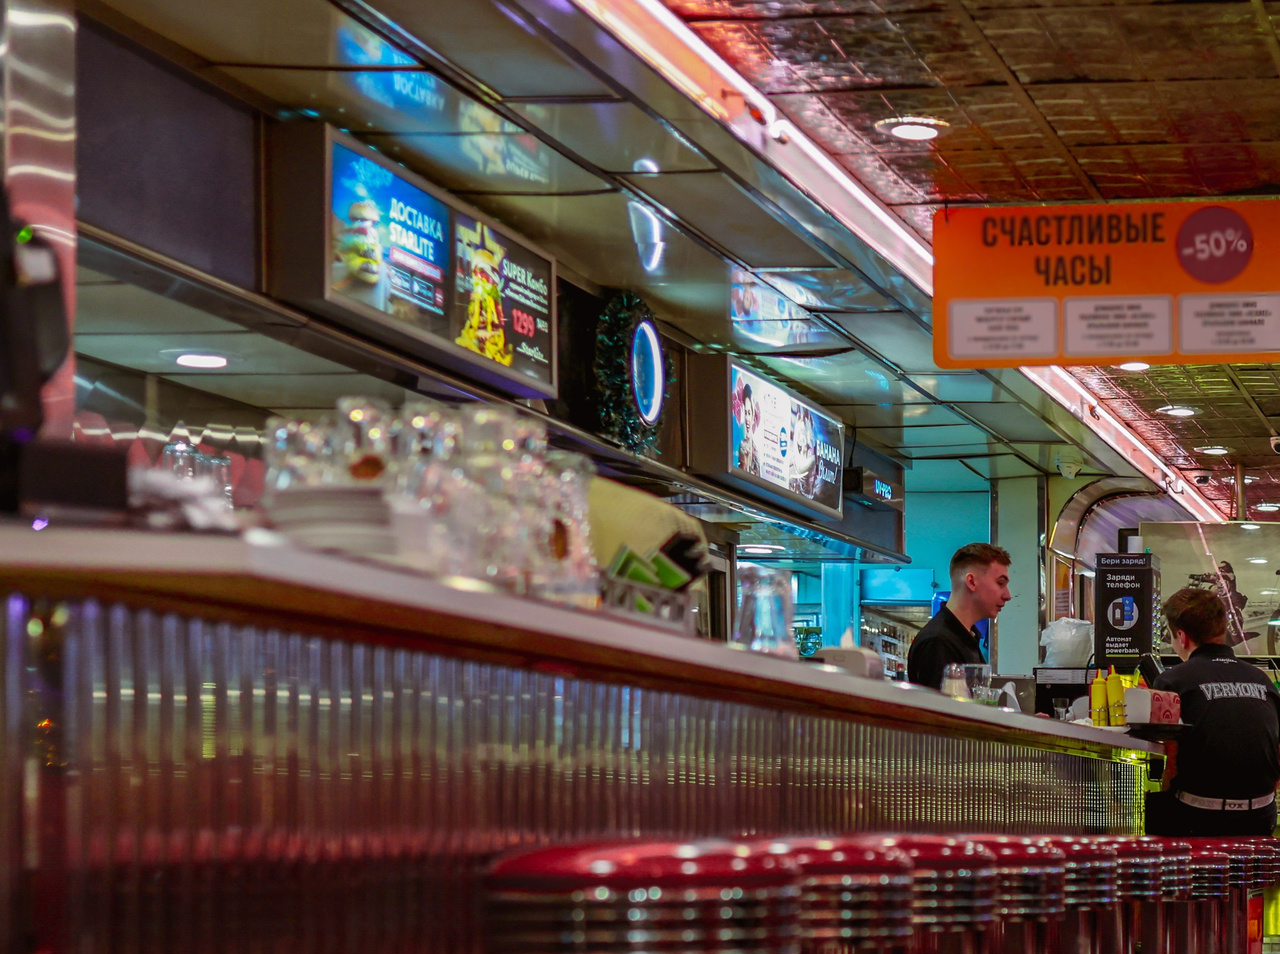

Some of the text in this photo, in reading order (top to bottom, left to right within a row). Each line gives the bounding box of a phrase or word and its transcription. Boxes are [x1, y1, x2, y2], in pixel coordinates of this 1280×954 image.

[389, 197, 443, 243] ДОСТАВКА
[982, 212, 1166, 247] СЧАСТЛИВЫЕ
[389, 221, 435, 261] STARLITE
[1182, 228, 1248, 261] -50%
[503, 258, 527, 285] SUPER
[1034, 255, 1112, 286] ЧАСЫ
[512, 308, 535, 338] 1299
[1101, 557, 1120, 565] Бери
[1106, 573, 1135, 581] Заряди
[1199, 682, 1268, 700] VERMONT
